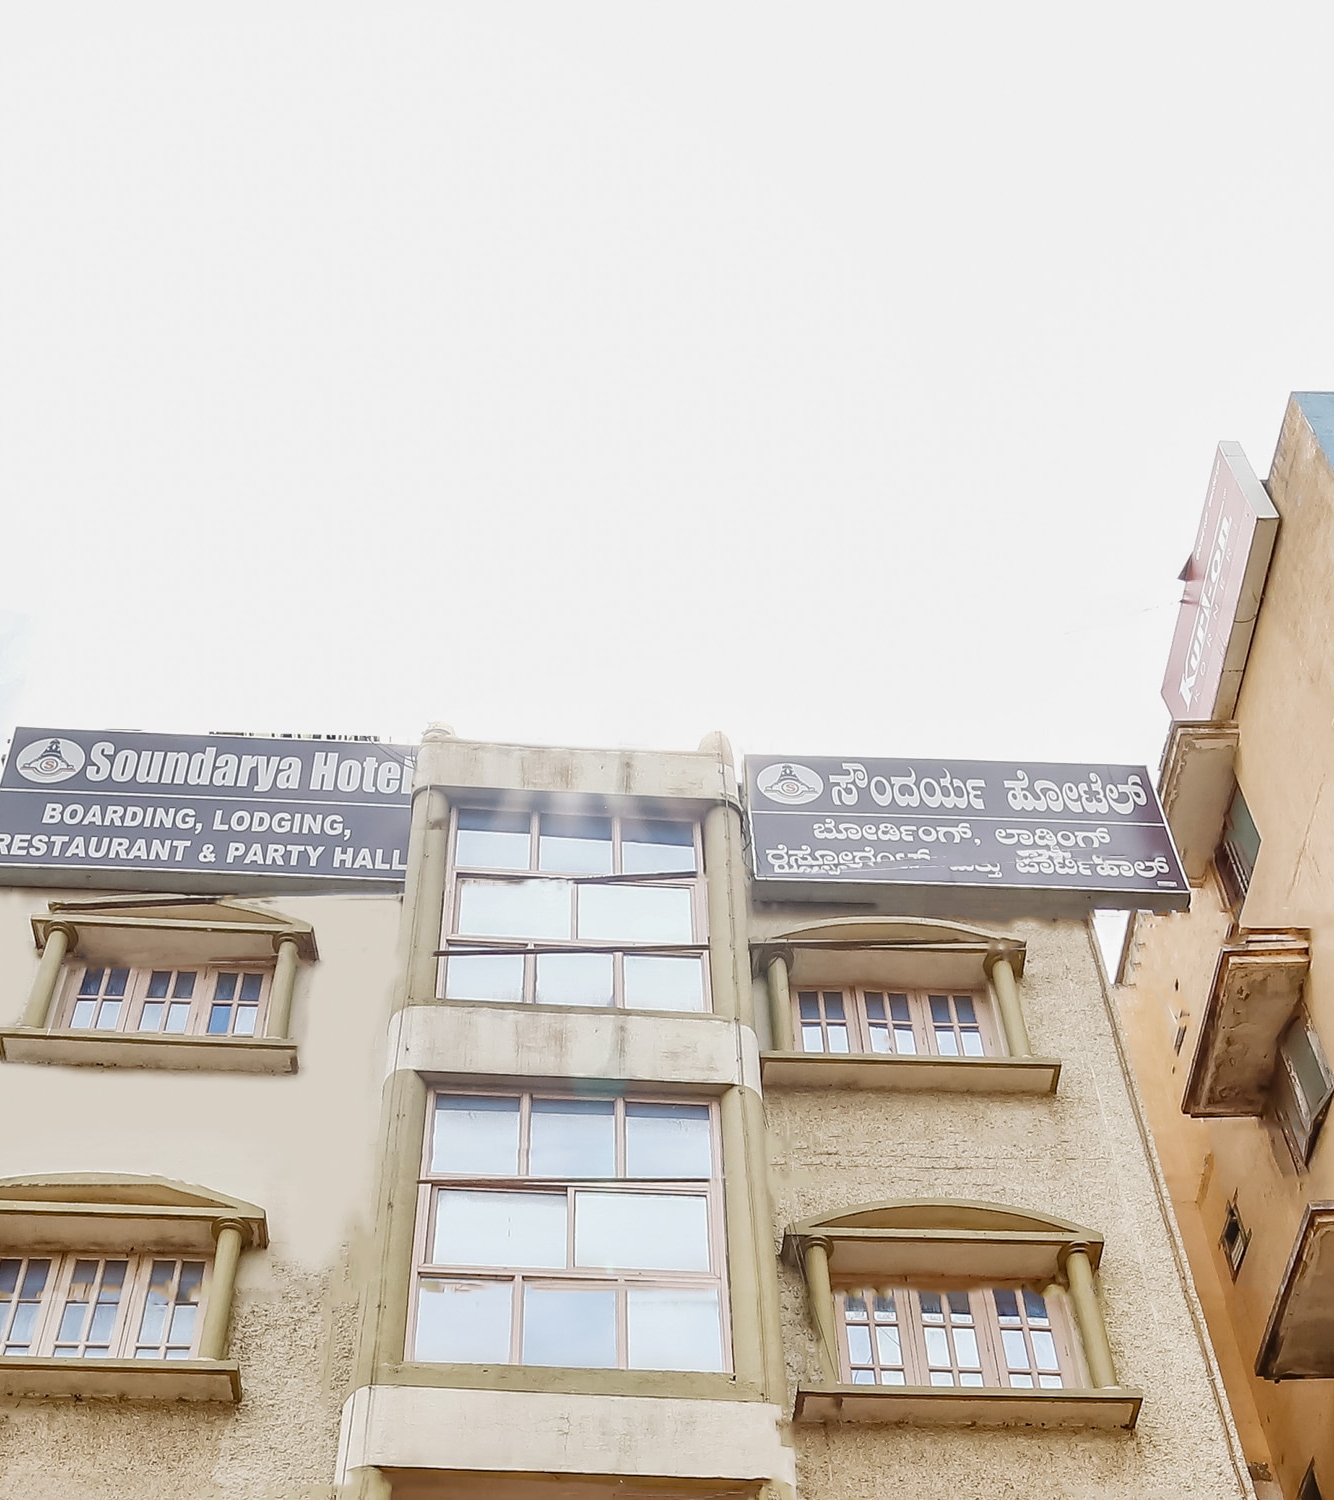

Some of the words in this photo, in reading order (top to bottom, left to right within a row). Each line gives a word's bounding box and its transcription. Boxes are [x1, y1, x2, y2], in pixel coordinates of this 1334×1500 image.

[85, 741, 302, 793] Soundarya
[829, 762, 987, 810] ಸೌಂದರ್ಯ
[41, 803, 204, 834] BOARDING,
[212, 809, 353, 840] LODGING,
[198, 843, 217, 864] &
[226, 843, 325, 867] PARTY
[333, 847, 409, 871] HALL
